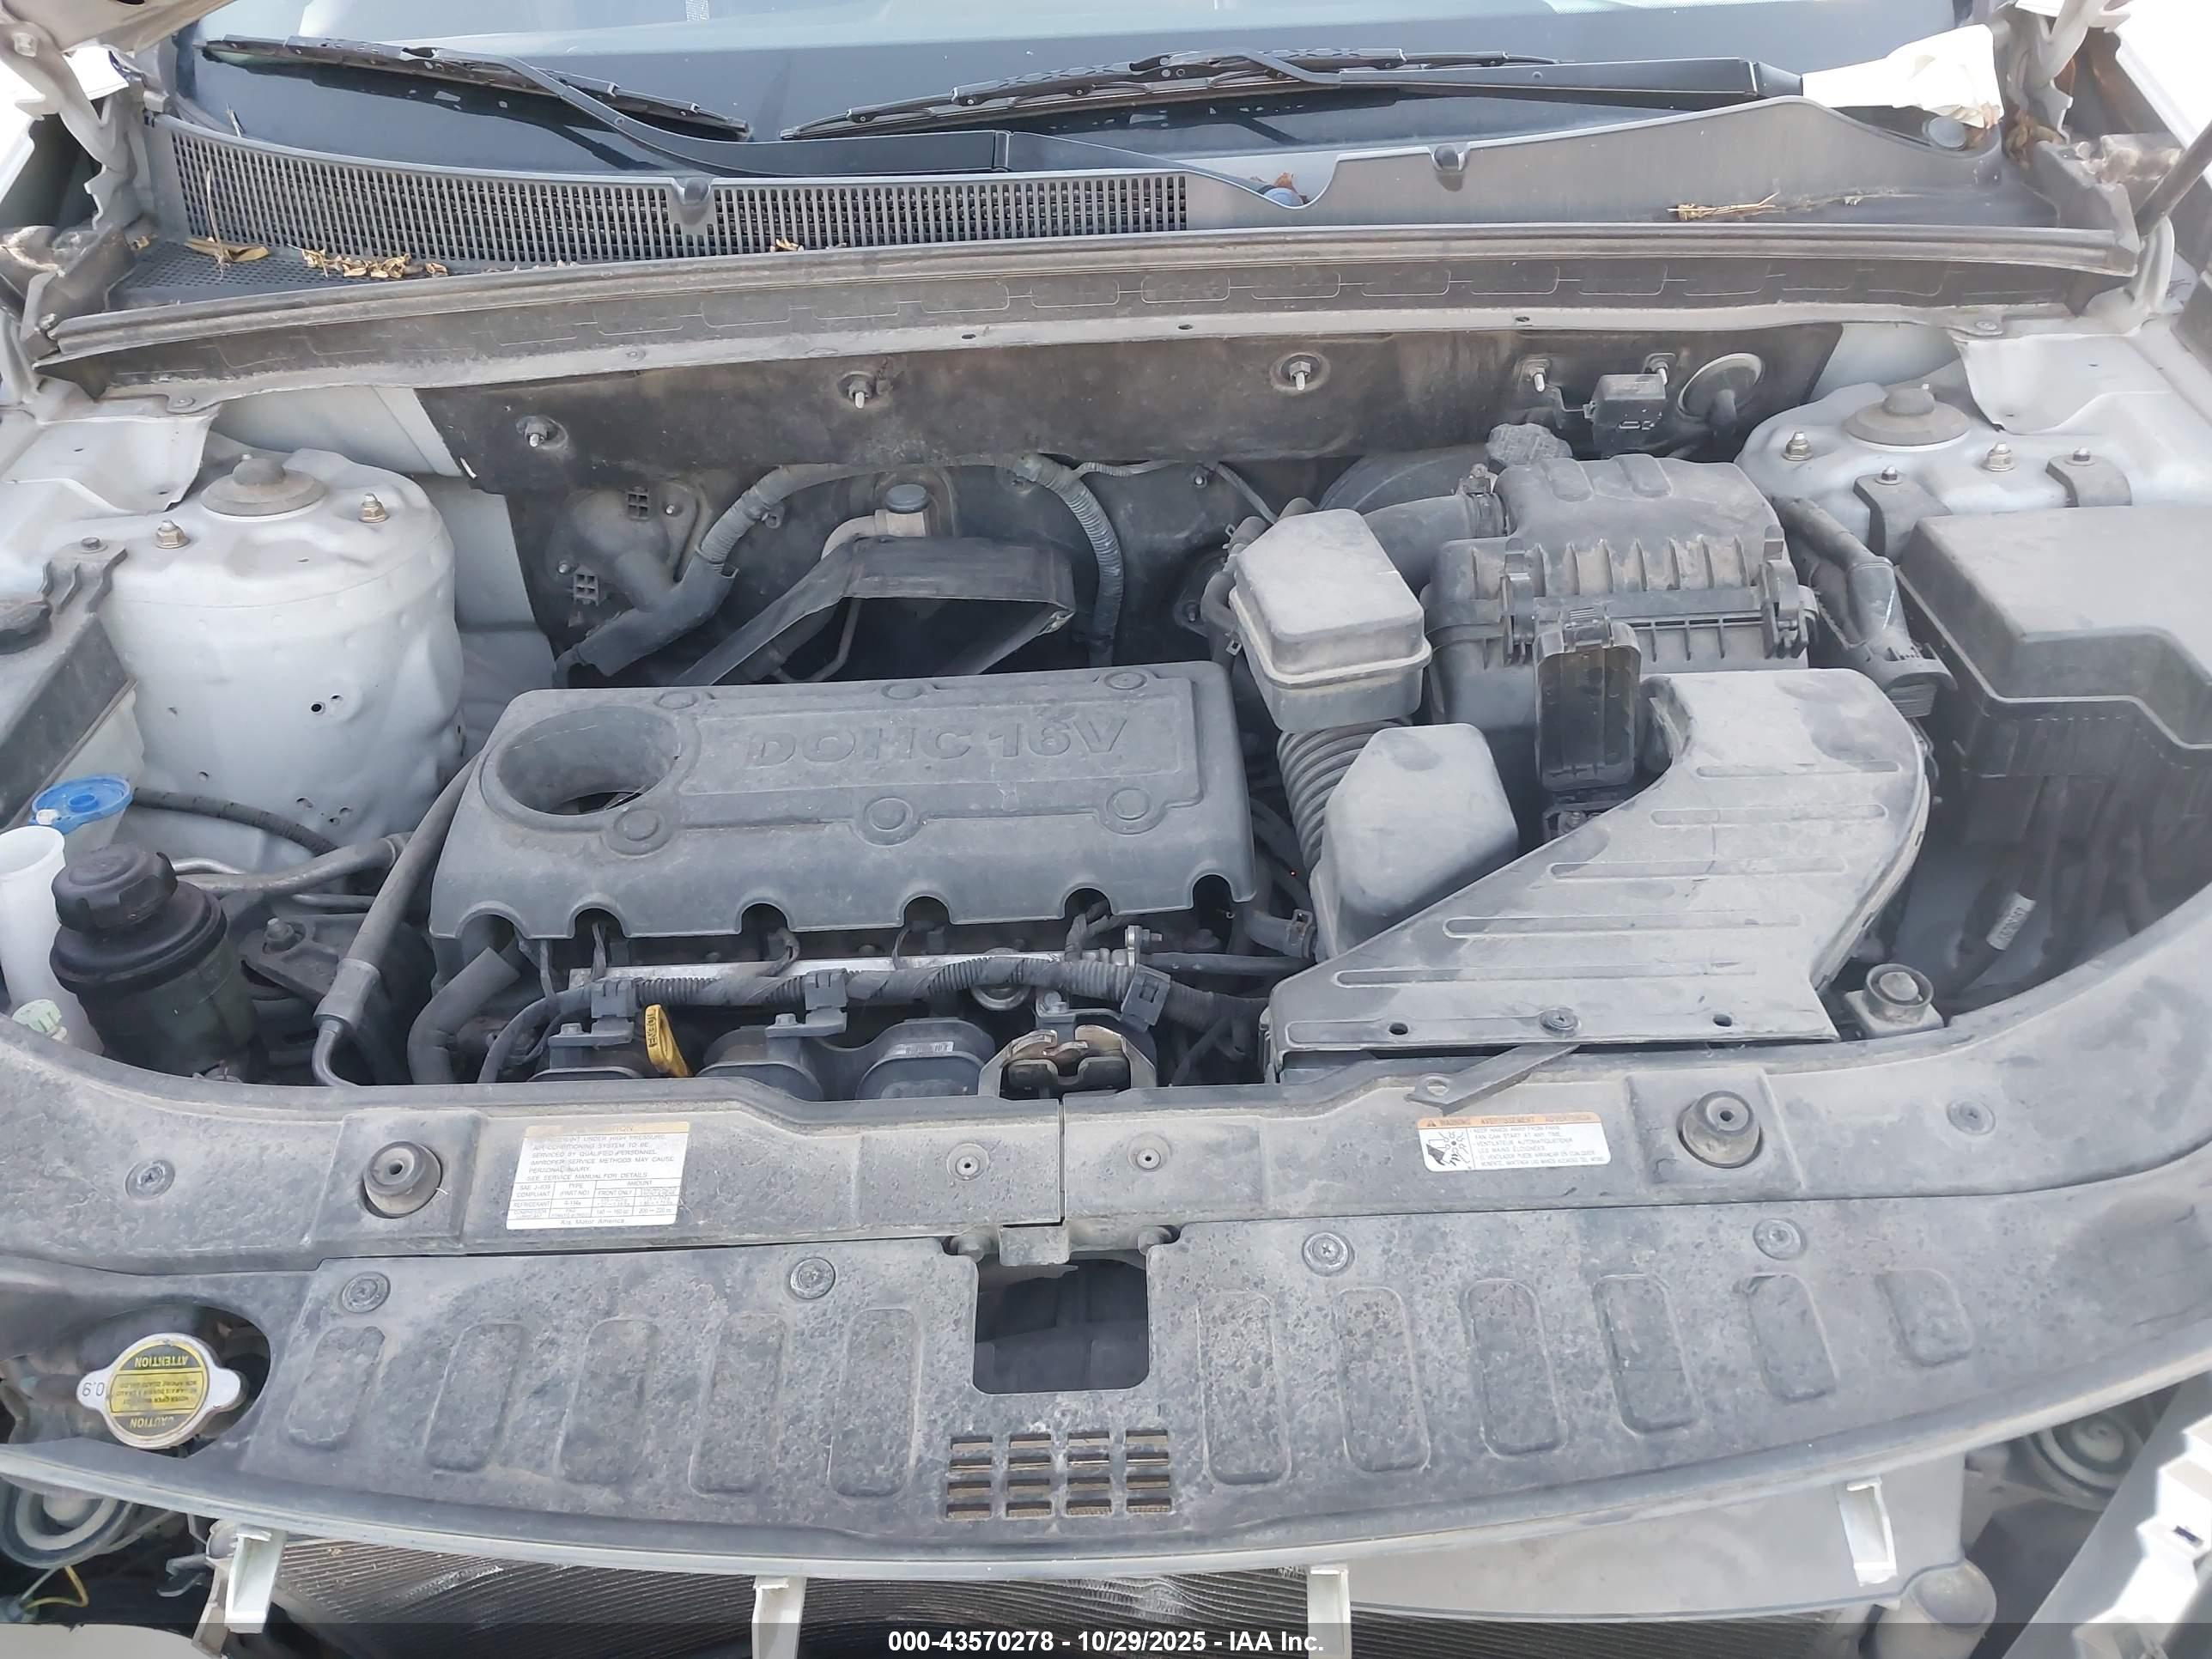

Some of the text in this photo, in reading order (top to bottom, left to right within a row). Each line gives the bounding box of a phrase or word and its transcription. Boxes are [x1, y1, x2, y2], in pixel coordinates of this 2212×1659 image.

[748, 718, 1128, 769] DOHC 16V
[135, 1356, 189, 1368] ATTENTION
[82, 1381, 105, 1397] 0.9
[130, 1417, 174, 1429] CAUTION
